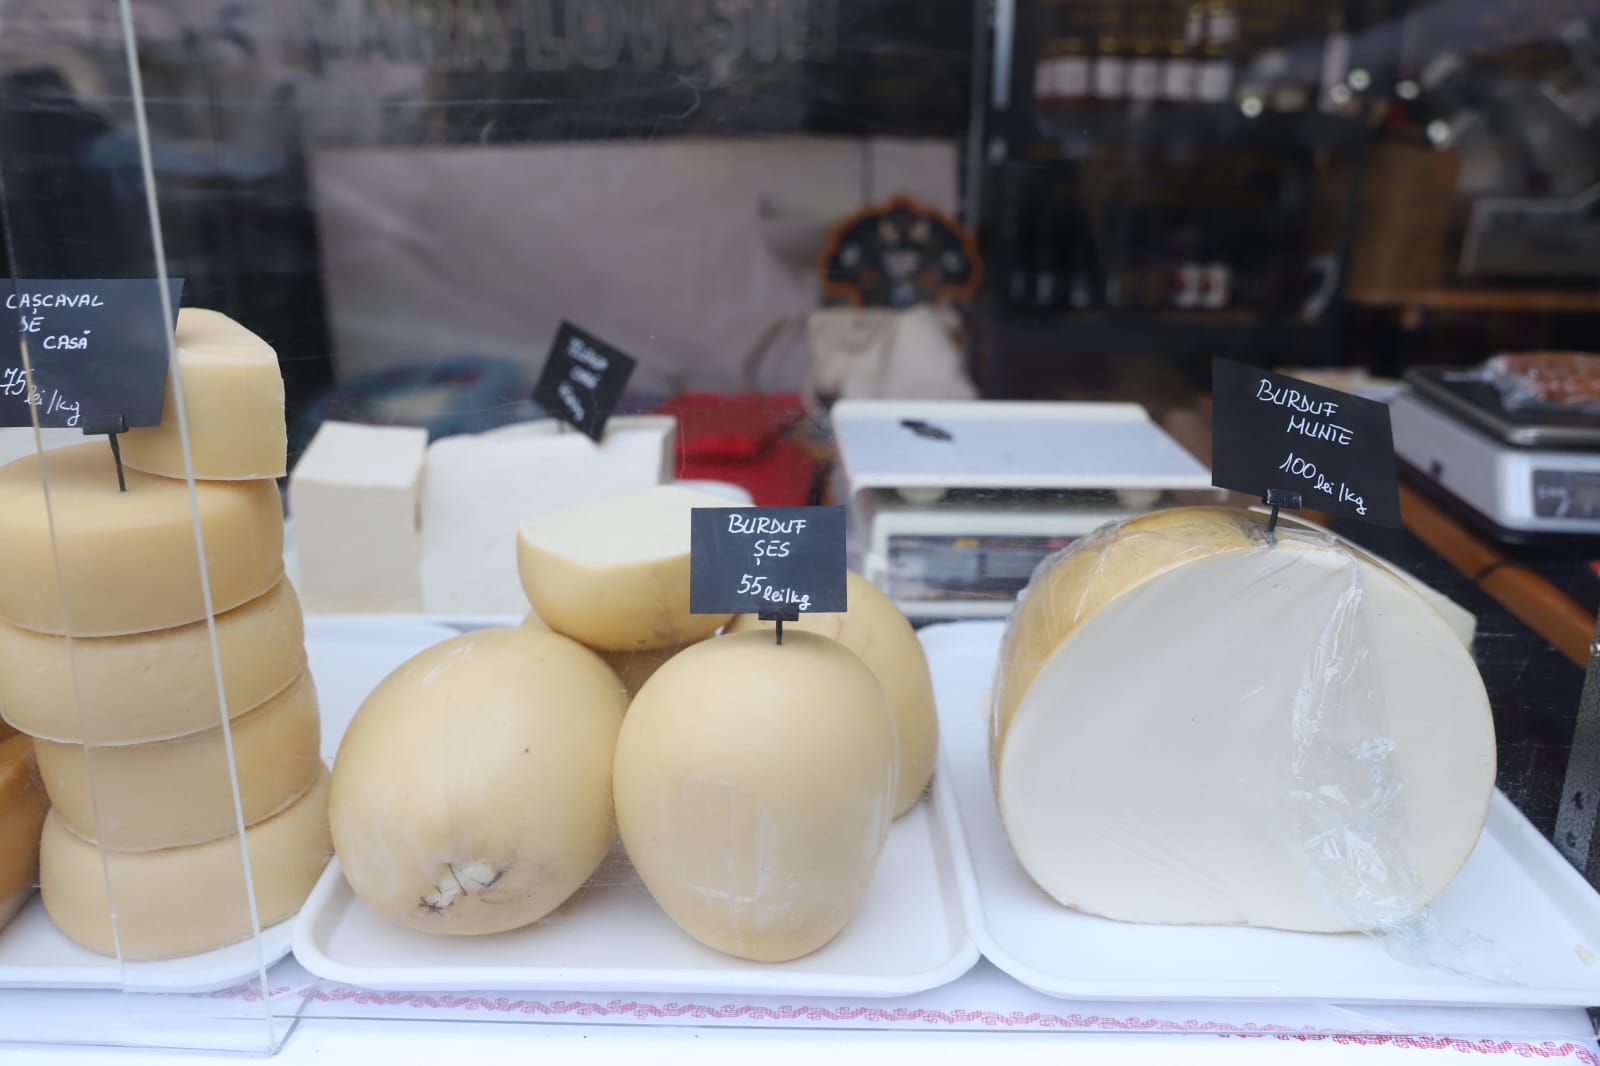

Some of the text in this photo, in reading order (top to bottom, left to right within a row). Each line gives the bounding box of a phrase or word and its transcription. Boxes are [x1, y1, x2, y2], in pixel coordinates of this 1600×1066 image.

[5, 293, 105, 314] CAȘCAVAL
[43, 330, 91, 350] CASĂ
[1256, 378, 1339, 417] BURDUF
[1286, 414, 1354, 446] MUNTE
[728, 513, 807, 535] BURDUF
[753, 539, 791, 567] ȘES
